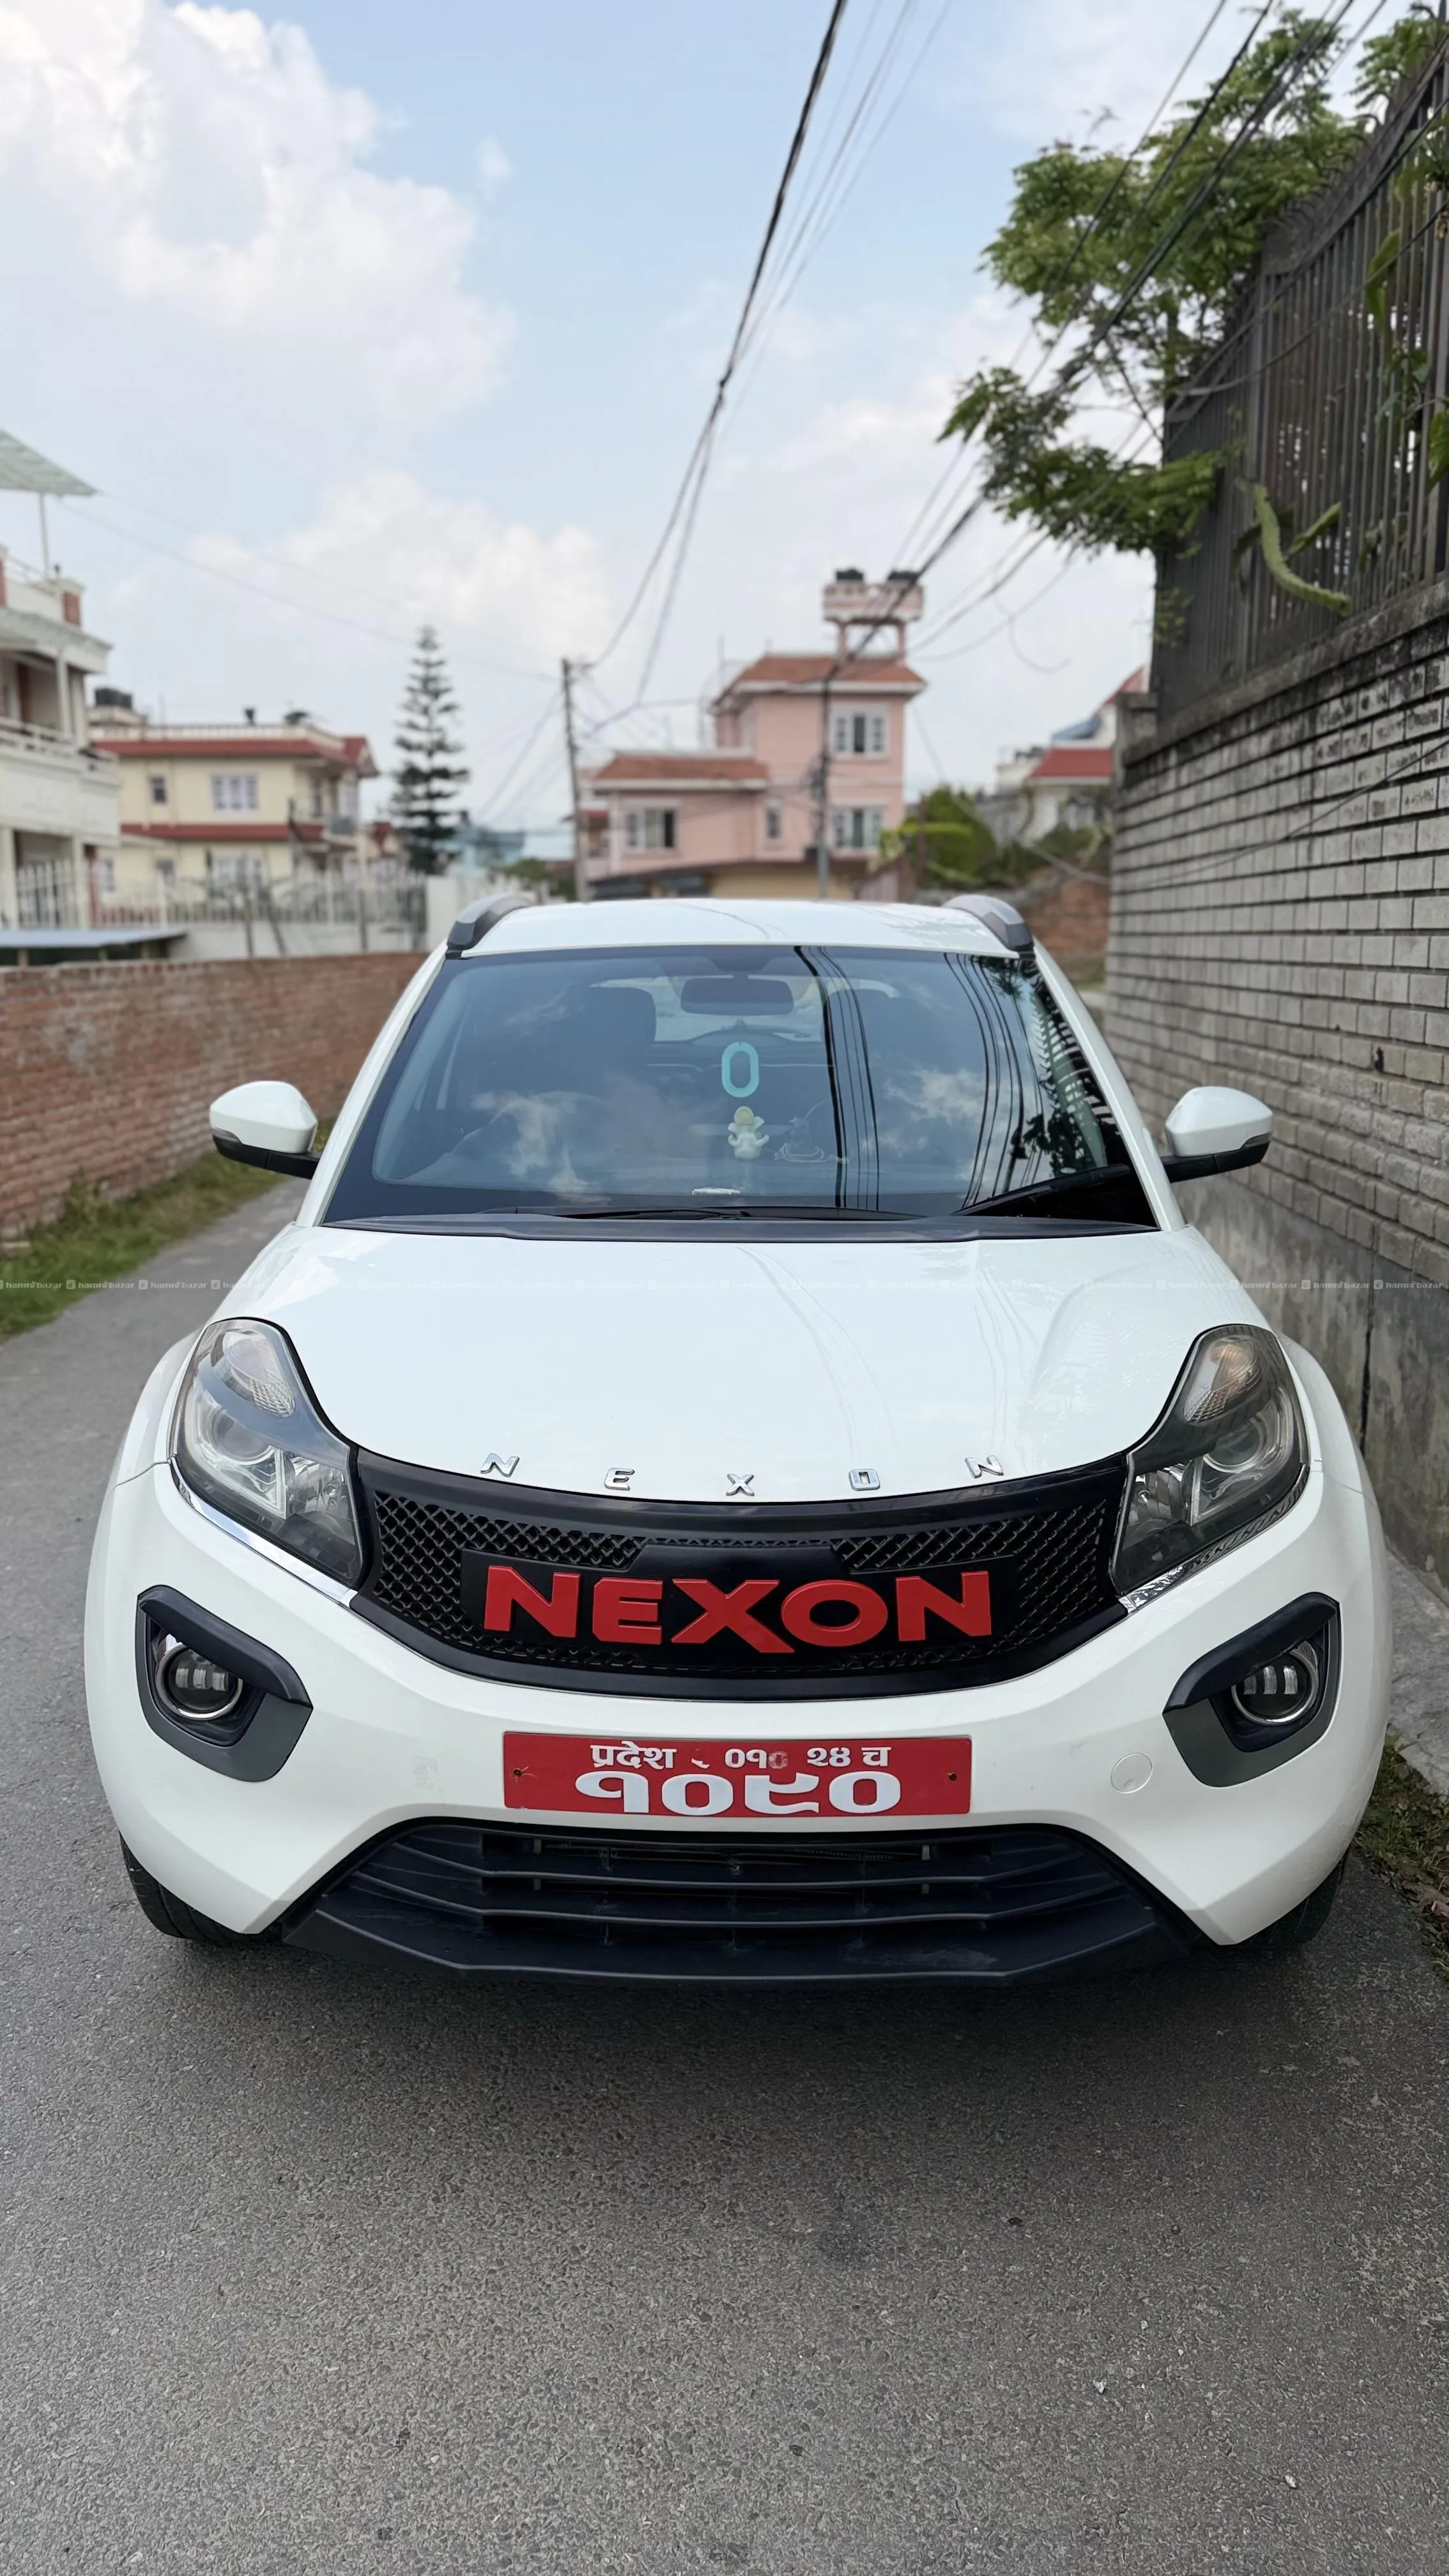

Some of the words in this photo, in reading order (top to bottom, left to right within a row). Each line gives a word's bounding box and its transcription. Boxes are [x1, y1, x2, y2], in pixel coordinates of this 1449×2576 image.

[483, 1565, 992, 1653] NEXON
[590, 1740, 678, 1770] प्रदेश
[861, 1746, 892, 1767] च
